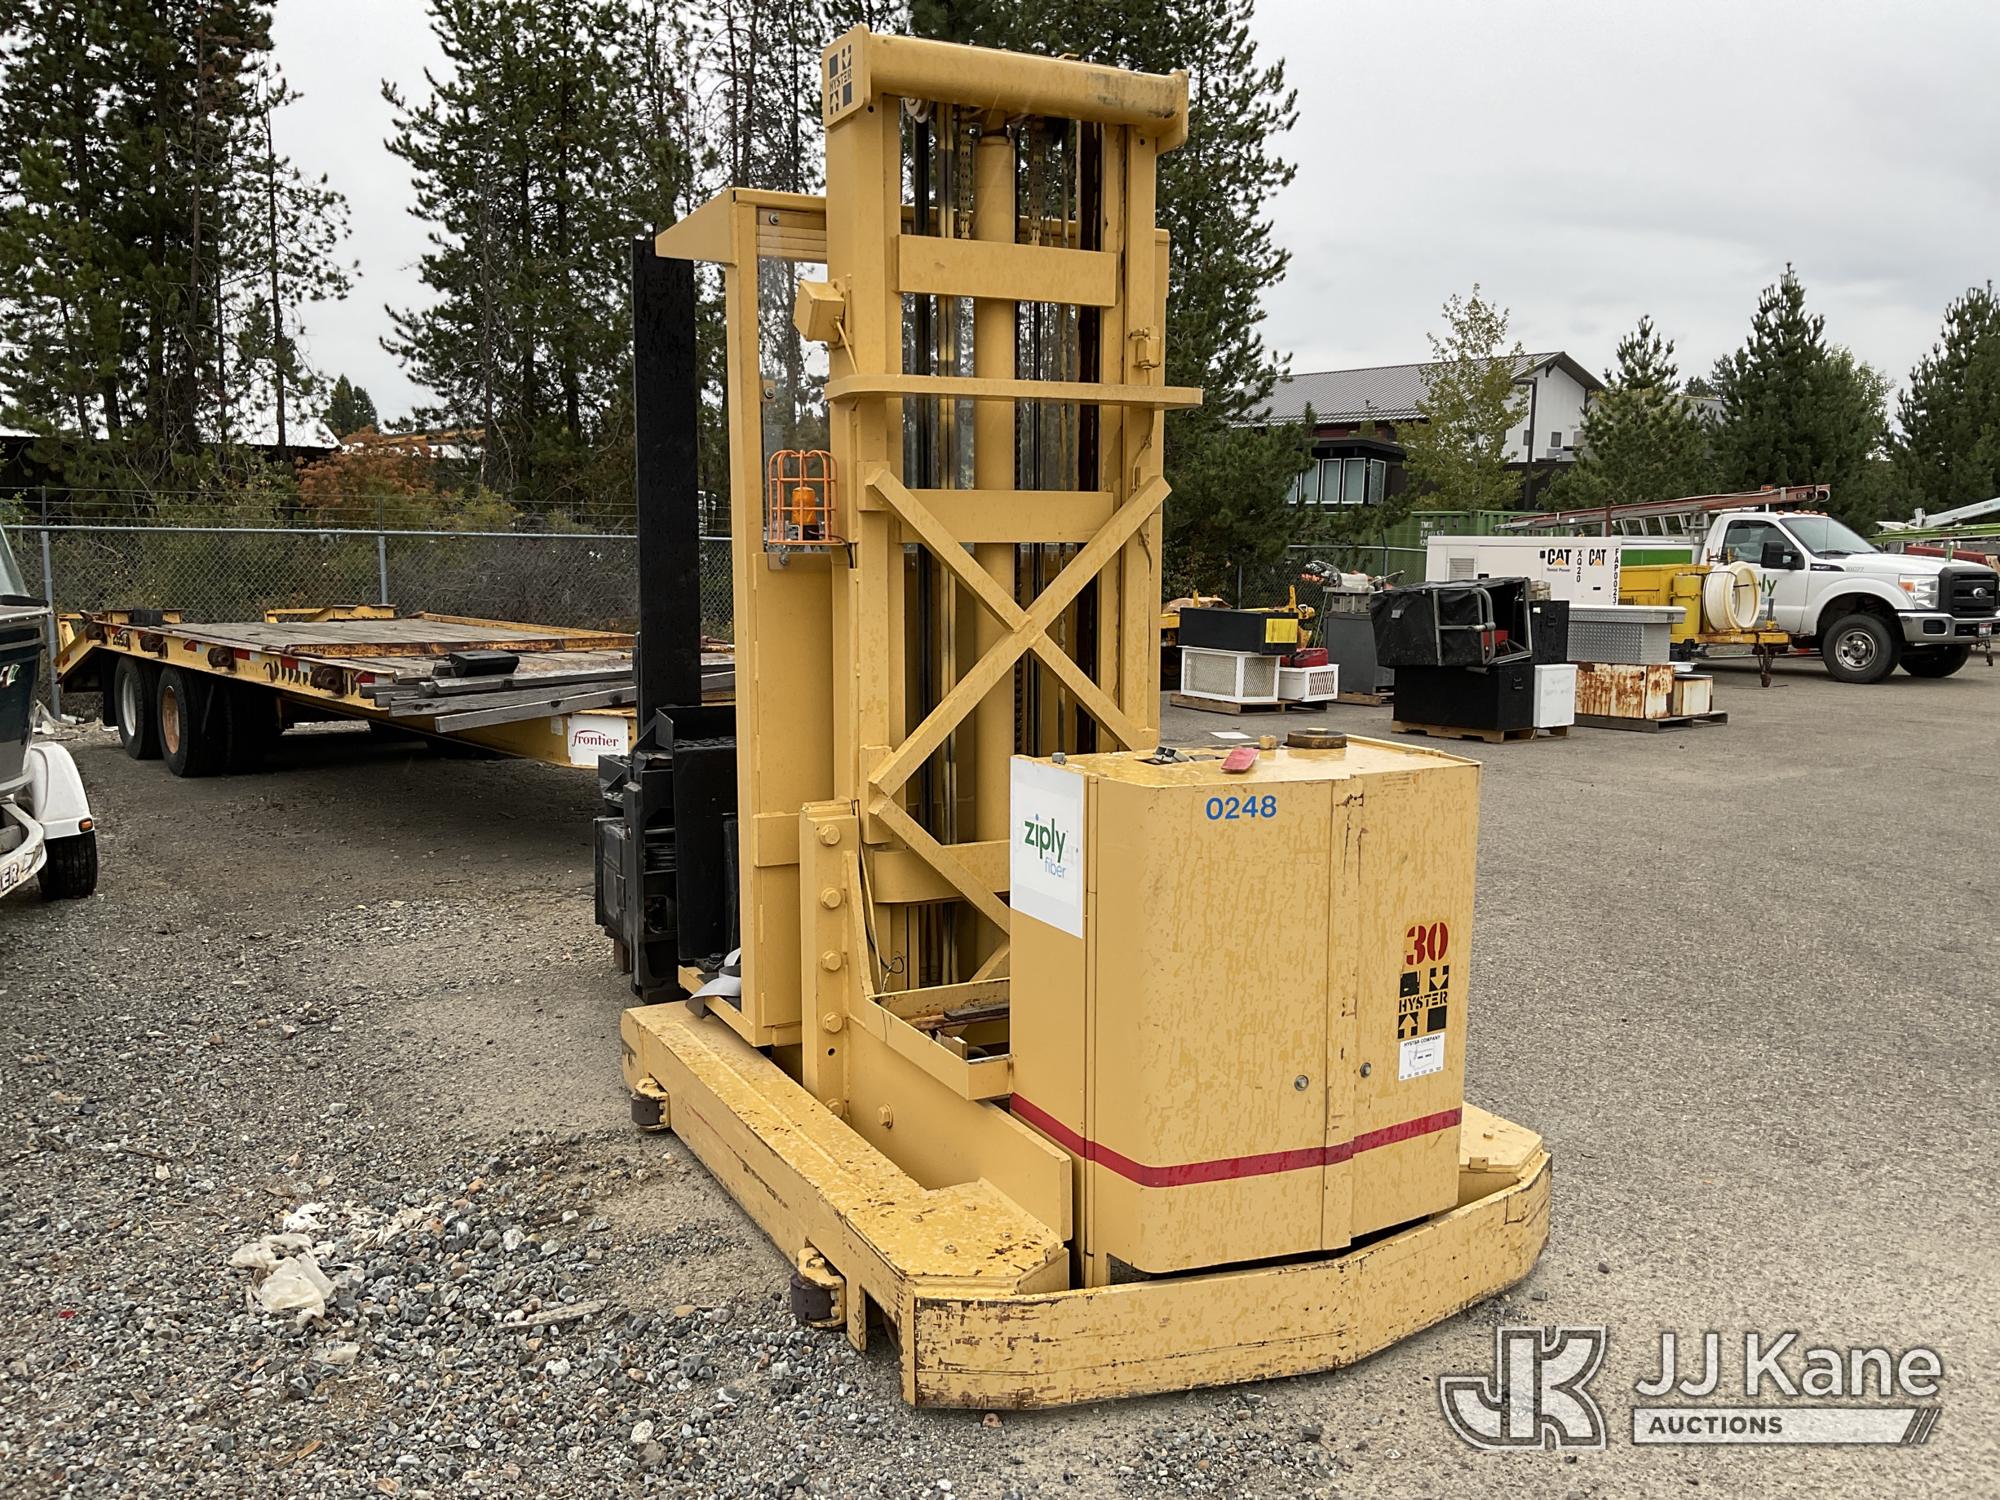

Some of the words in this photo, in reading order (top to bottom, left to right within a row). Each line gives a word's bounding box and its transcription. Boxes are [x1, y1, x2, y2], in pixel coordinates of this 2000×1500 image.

[830, 67, 852, 92] HYSTER
[1547, 548, 1572, 566] CAT
[1588, 548, 1607, 566] CAT
[572, 729, 619, 747] frontier
[1206, 795, 1277, 820] 0248
[1024, 813, 1066, 863] ziply
[1044, 856, 1066, 878] fiber
[1406, 922, 1449, 966] 30
[1398, 991, 1448, 1014] HYSTER
[1420, 1034, 1441, 1044] COMPANY
